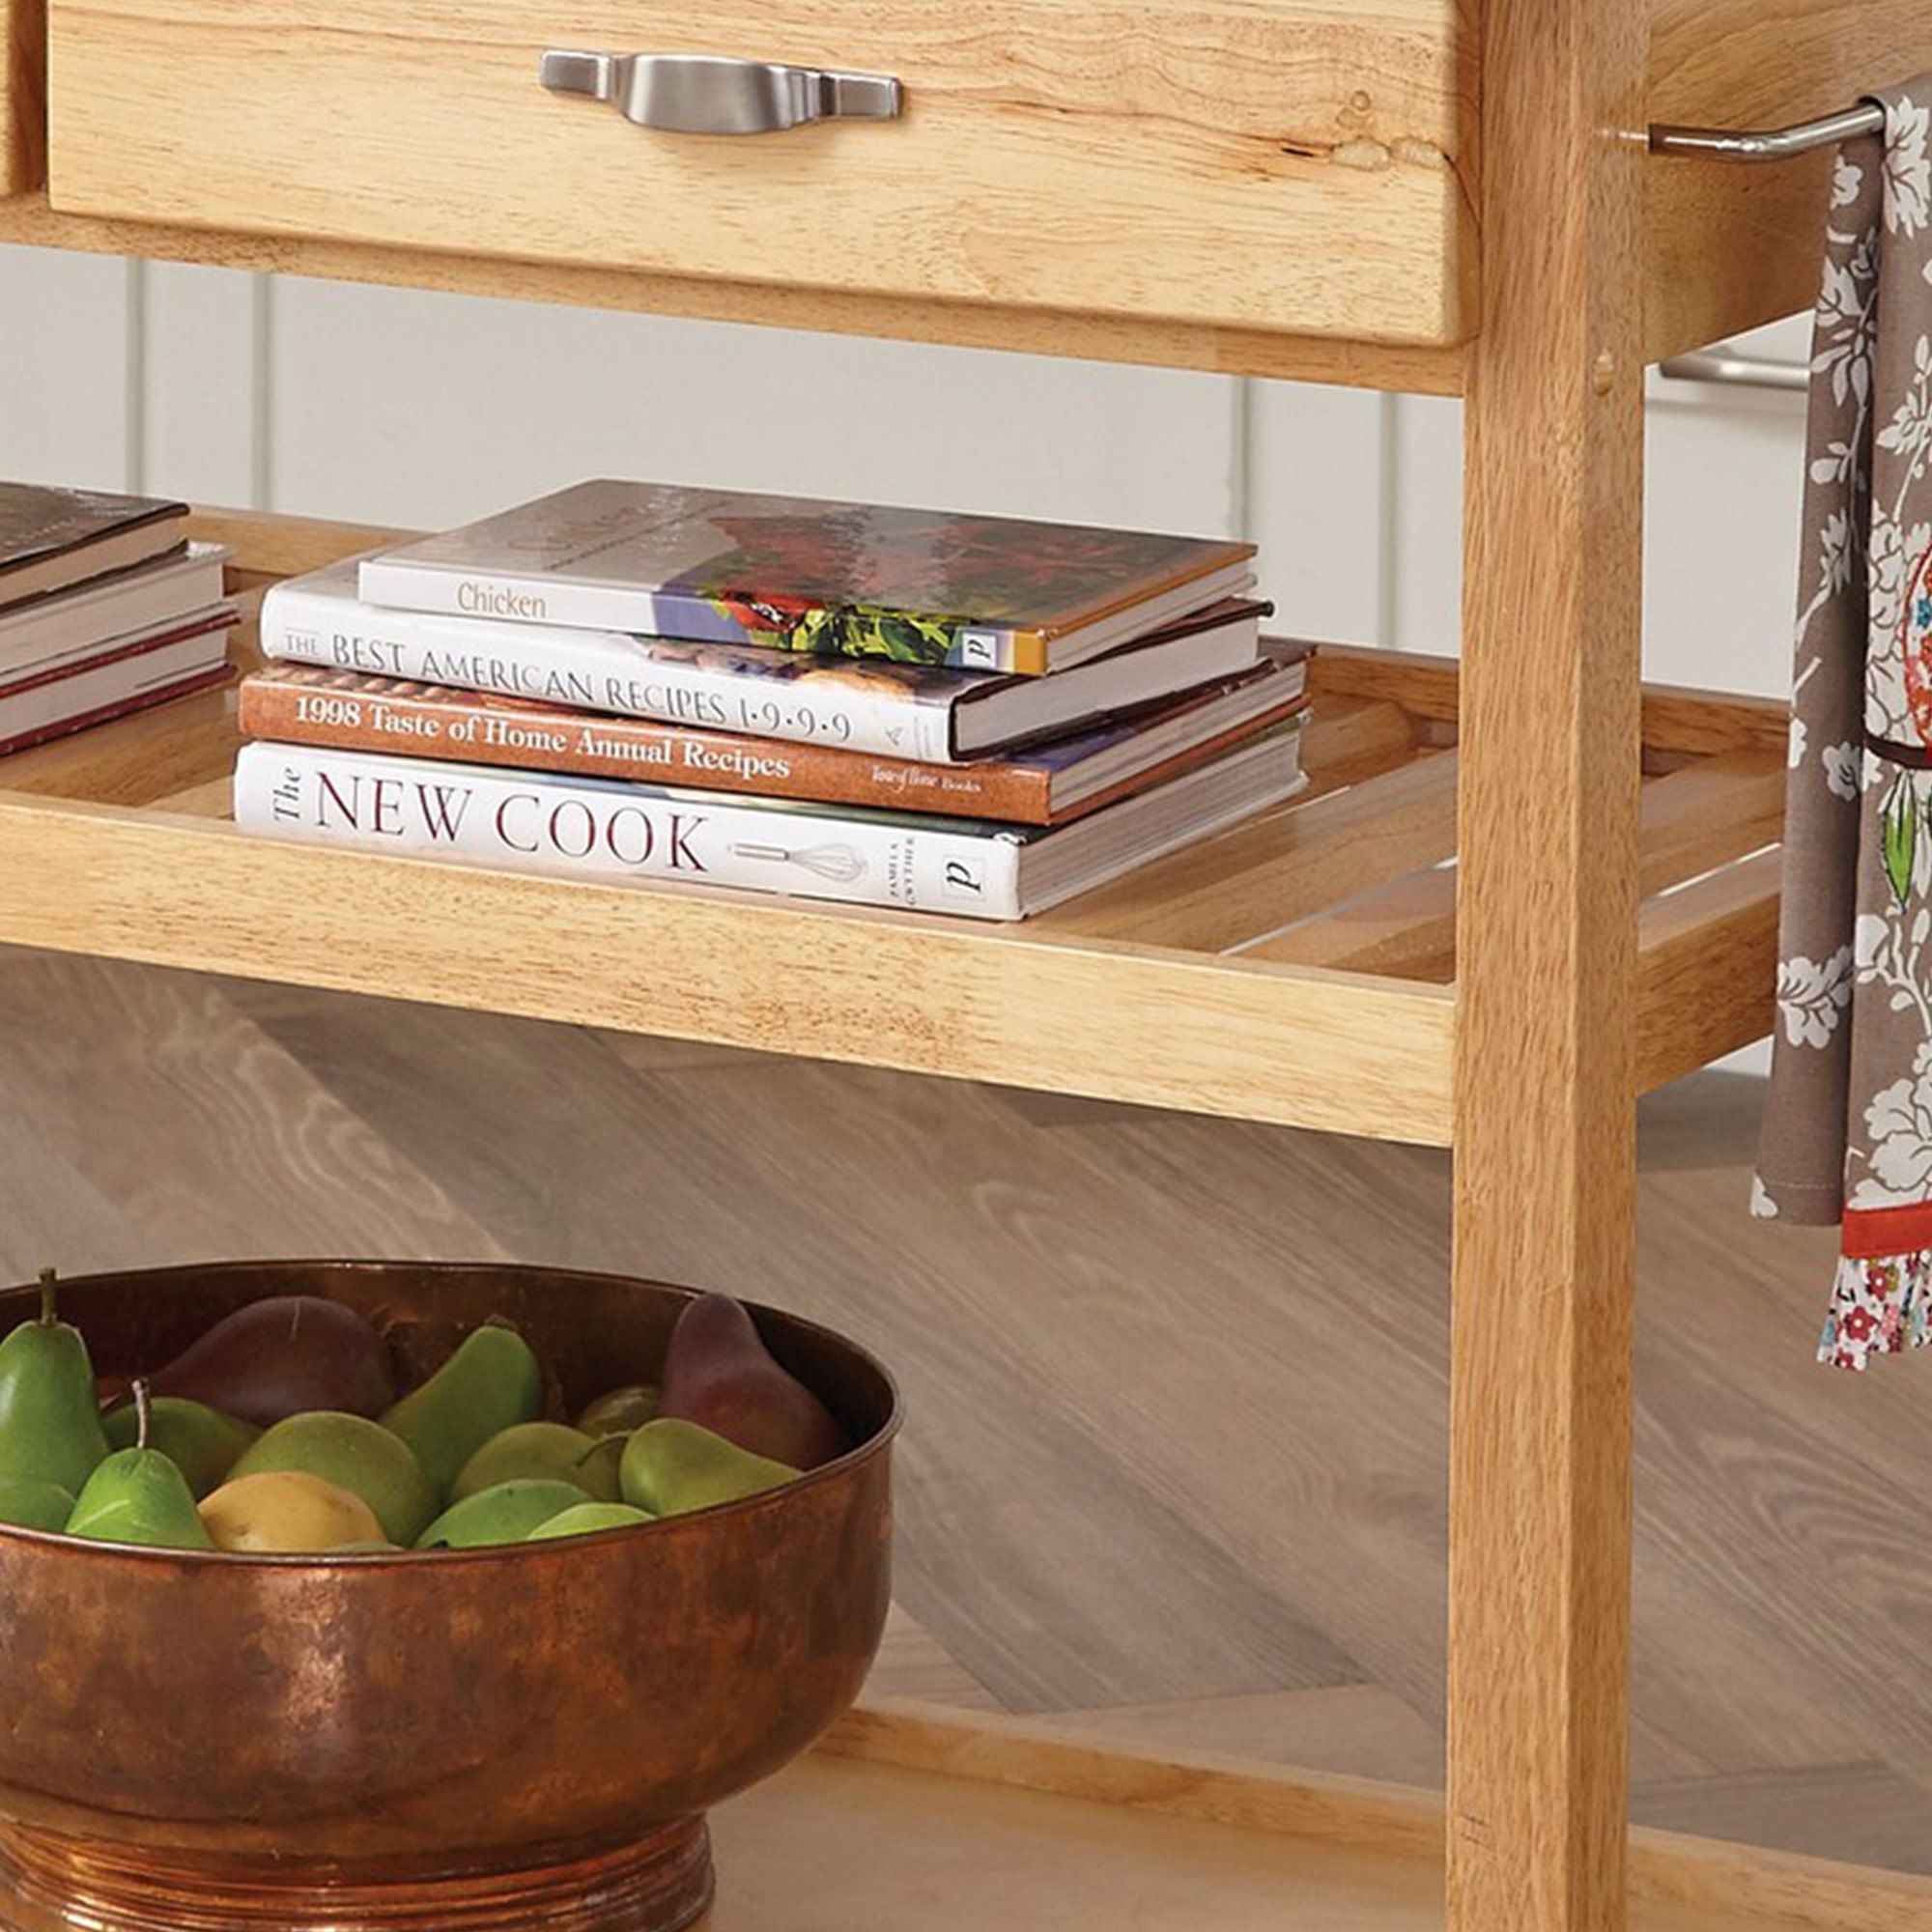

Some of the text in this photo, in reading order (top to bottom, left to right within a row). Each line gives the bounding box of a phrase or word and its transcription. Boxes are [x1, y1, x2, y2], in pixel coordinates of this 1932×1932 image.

[457, 582, 547, 617] Chicken
[285, 634, 320, 656] THE
[332, 634, 406, 673] BEST
[421, 651, 594, 702] AMERICAN
[606, 677, 726, 724] RECIPES
[296, 696, 790, 780] 1998 Taste of Home Annual Recipes
[272, 767, 301, 821] The
[315, 771, 709, 872] NEW COOK
